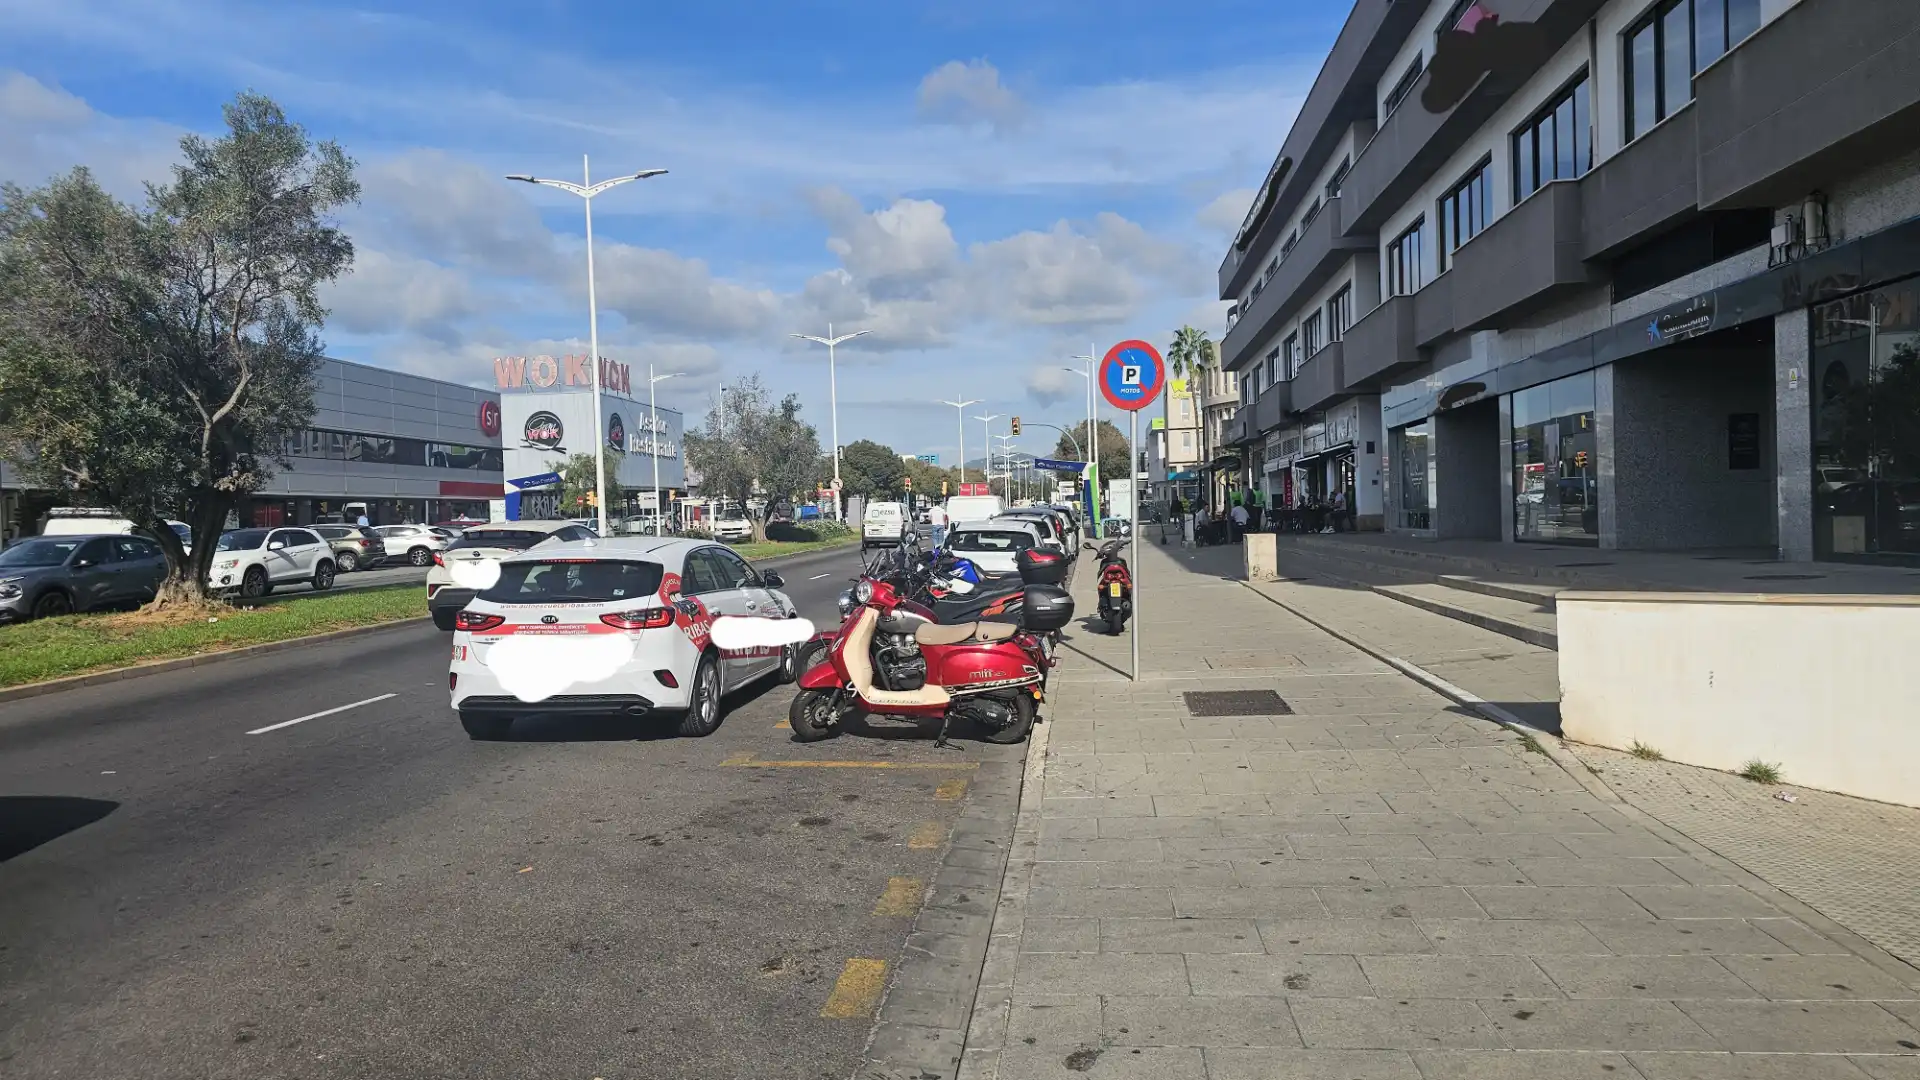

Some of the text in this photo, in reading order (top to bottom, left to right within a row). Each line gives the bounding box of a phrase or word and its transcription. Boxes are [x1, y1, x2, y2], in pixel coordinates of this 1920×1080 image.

[494, 354, 588, 389] WOK
[1125, 368, 1137, 382] P
[527, 427, 560, 440] WOK
[684, 620, 712, 640] RIBAS
